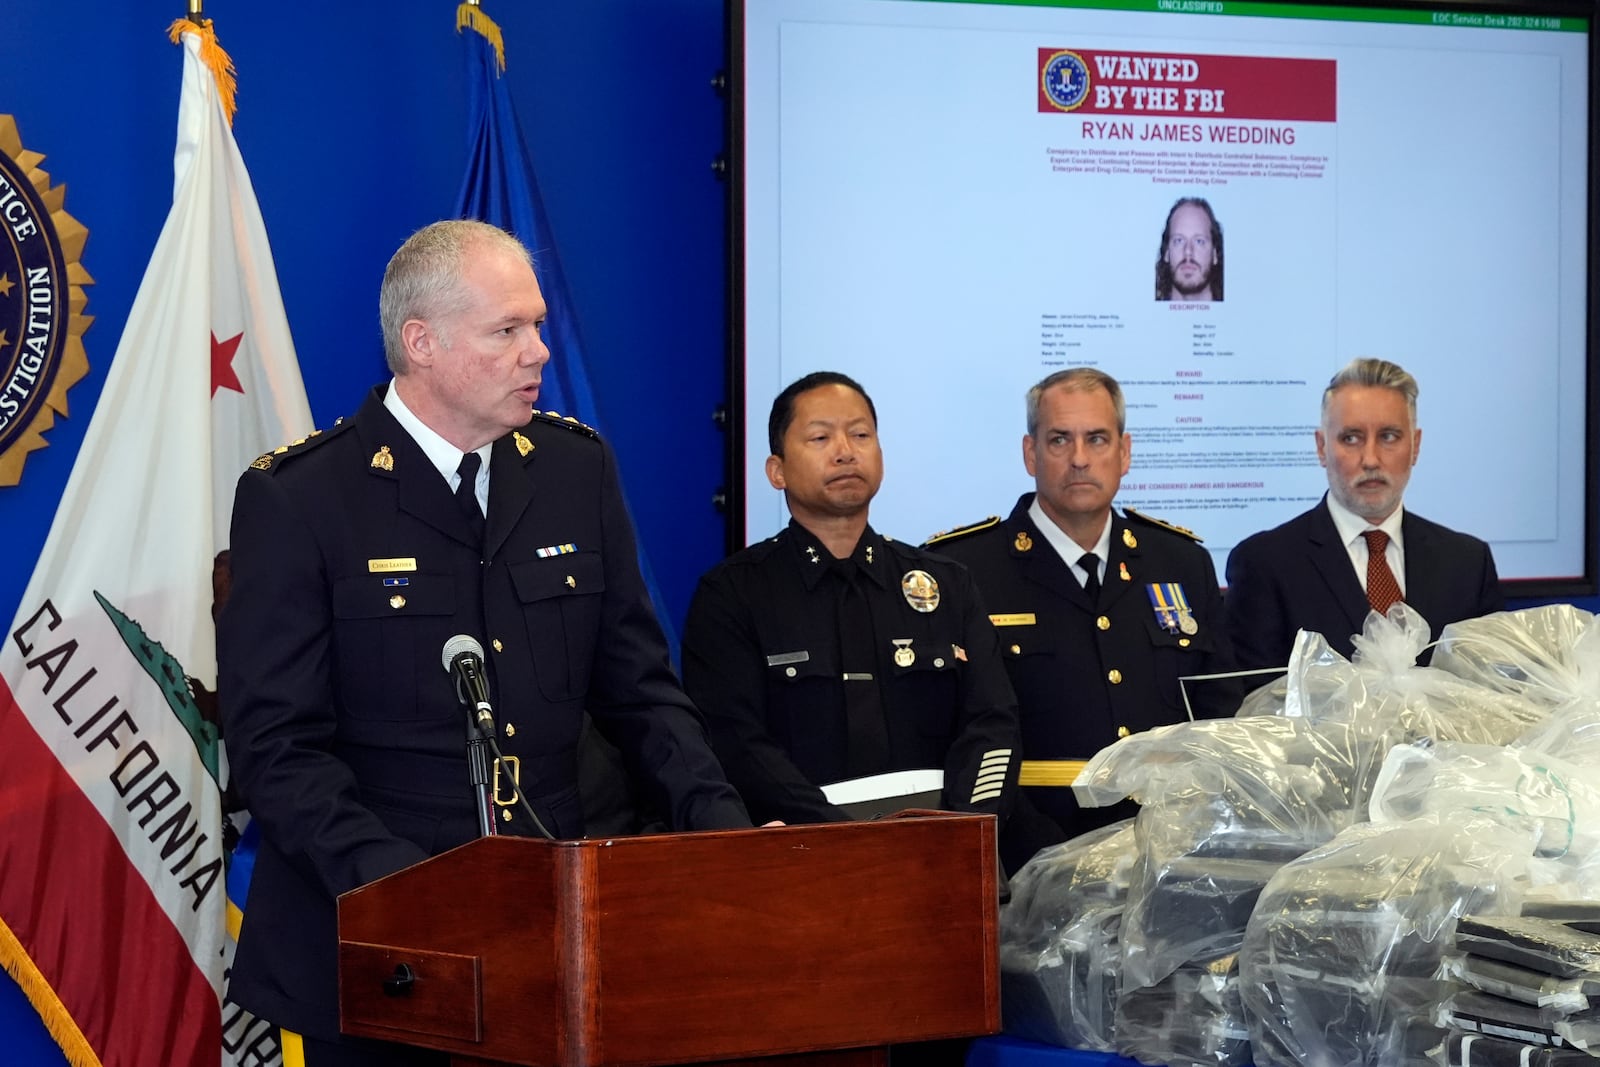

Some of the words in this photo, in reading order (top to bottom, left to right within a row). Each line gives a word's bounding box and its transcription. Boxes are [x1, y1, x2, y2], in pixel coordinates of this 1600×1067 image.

[1158, 0, 1223, 12] UNCLASSIFIED
[1094, 56, 1199, 82] WANTED
[1095, 86, 1128, 109] BY
[1130, 86, 1178, 111] THE
[1184, 88, 1224, 112] FBI
[1082, 121, 1134, 140] RYAN
[1140, 122, 1203, 142] JAMES
[1209, 125, 1296, 145] WEDDING
[13, 598, 223, 912] CALIFORNIA
